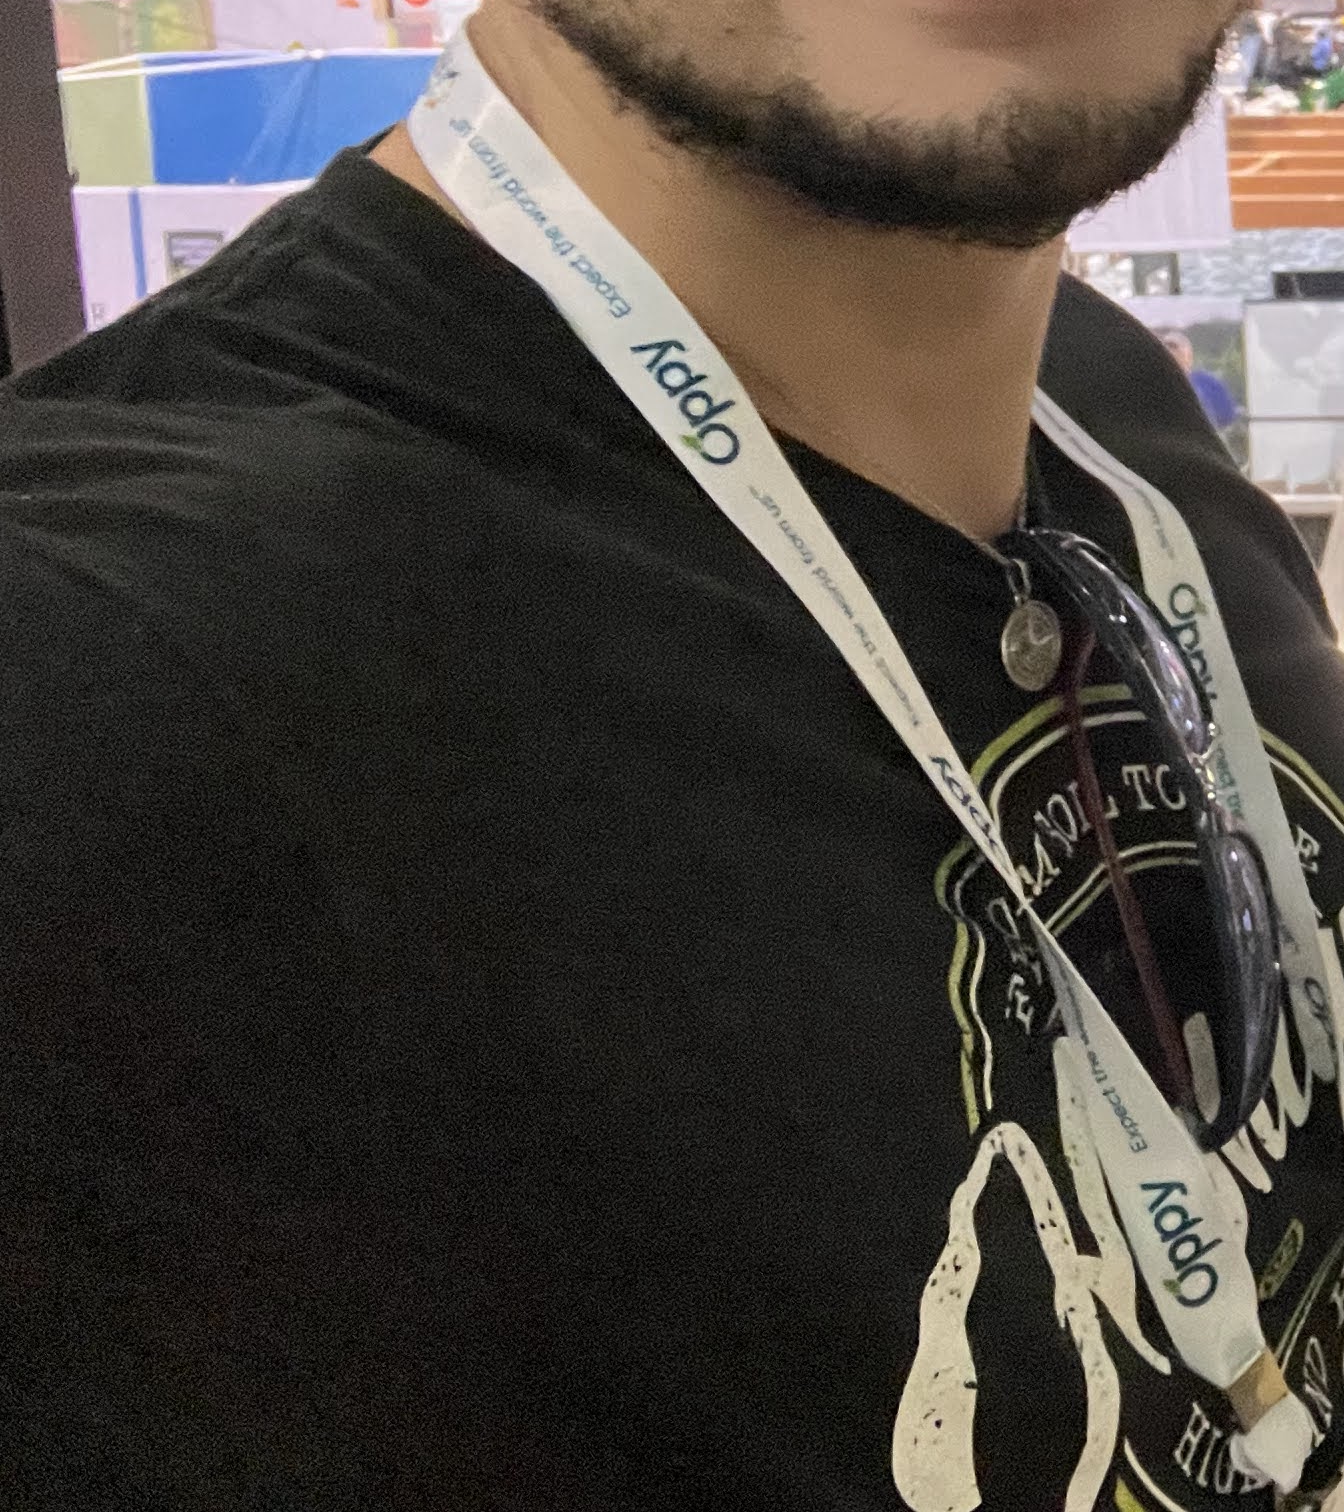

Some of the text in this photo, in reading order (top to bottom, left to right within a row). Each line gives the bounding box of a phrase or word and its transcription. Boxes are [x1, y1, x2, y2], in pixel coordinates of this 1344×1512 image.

[544, 225, 577, 257] the
[569, 252, 632, 319] Expect
[630, 339, 740, 465] Oppy
[1101, 1086, 1149, 1155] Expect
[1140, 1179, 1223, 1309] Oppy
